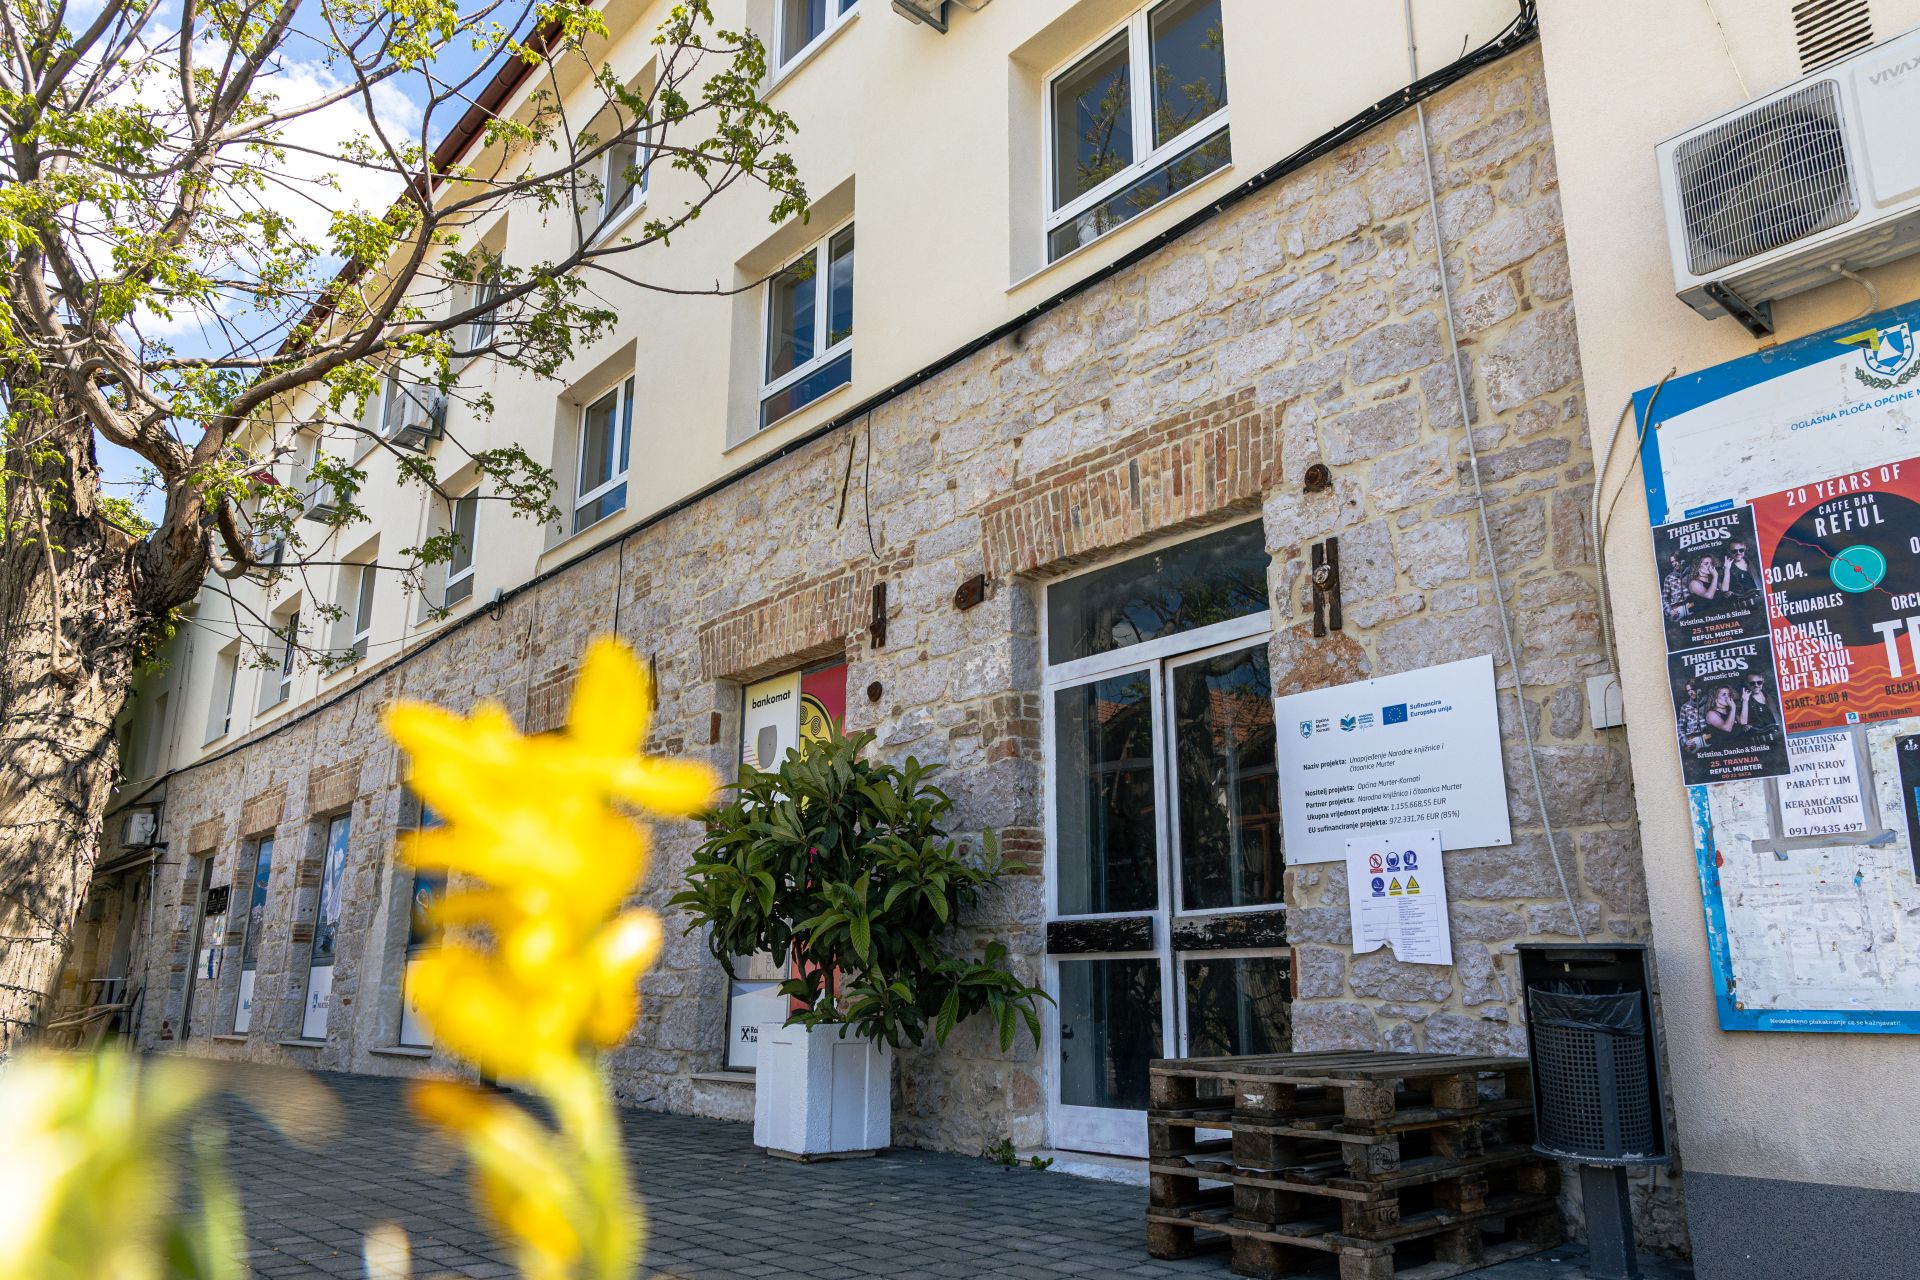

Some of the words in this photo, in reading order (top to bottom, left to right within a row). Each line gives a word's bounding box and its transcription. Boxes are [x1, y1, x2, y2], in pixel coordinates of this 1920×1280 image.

[1791, 413, 1837, 430] OGLASNA
[1839, 403, 1872, 417] PLOČA
[1786, 488, 1807, 506] 20
[1815, 471, 1871, 498] YEARS
[1880, 464, 1900, 482] OF
[1819, 500, 1850, 515] CAFFE
[1854, 494, 1875, 507] BAR
[1667, 522, 1701, 539] THREE
[1703, 513, 1740, 528] LITTLE
[1814, 504, 1885, 538] REFUL
[1680, 526, 1731, 549] BIRDS
[1687, 542, 1711, 552] acoustic
[1765, 562, 1808, 584] 30.04.
[1768, 591, 1788, 606] THE
[1771, 592, 1844, 619] EXPENDABLES
[1705, 613, 1726, 621] Danko
[1691, 634, 1714, 642] REFUL
[1714, 628, 1744, 638] MURTER
[1705, 621, 1741, 632] TRAVNJA
[1773, 619, 1832, 645] RAPHAEL
[1681, 651, 1717, 667] THREE
[1720, 644, 1758, 658] LITTLE
[1776, 633, 1843, 660] WRESSNIG
[1695, 657, 1749, 678] BIRDS
[1779, 659, 1789, 676] &
[1791, 654, 1816, 675] THE
[1819, 649, 1855, 670] SOUL
[1703, 673, 1727, 681] acoustic
[1782, 673, 1809, 692] GIFT
[1812, 666, 1850, 688] BAND
[1885, 681, 1914, 696] BEACH
[752, 690, 791, 709] bankomat
[1409, 699, 1442, 710] Sufinancira
[1785, 697, 1813, 710] START:
[1815, 692, 1839, 705] 20:00
[1410, 708, 1437, 717] Europska
[1438, 705, 1452, 713] unija
[1320, 759, 1347, 769] projekta:
[1388, 749, 1412, 758] Narodne
[1414, 744, 1440, 754] knjižnice
[1724, 747, 1745, 756] Danko
[1791, 743, 1836, 756] LIMARIJA
[1376, 760, 1395, 768] Murter
[1709, 767, 1732, 775] REFUL
[1733, 763, 1763, 772] MURTER
[1723, 756, 1759, 766] TRAVNJA
[1792, 763, 1816, 773] AVNI
[1818, 760, 1846, 770] KROV
[1305, 787, 1327, 797] Nositelj
[1328, 785, 1355, 795] projekta:
[1378, 774, 1421, 787] Murter-Kornati
[1786, 777, 1831, 790] PARAPET
[1833, 776, 1851, 785] LIM
[1328, 797, 1355, 807] projekta:
[1358, 793, 1381, 802] Narodna
[1383, 789, 1408, 799] knjižnica
[1441, 783, 1462, 791] Murter
[1785, 795, 1859, 809] KERAMIČARSKI
[1307, 813, 1329, 821] Ukupna
[1330, 808, 1361, 818] vrijednost
[1361, 805, 1389, 815] projekta:
[1433, 797, 1447, 805] EUR
[1804, 806, 1842, 816] RADOVI
[1308, 826, 1316, 834] EU
[1317, 821, 1359, 833] sufinanciranje
[1360, 819, 1388, 829] projekta:
[1427, 812, 1440, 820] EUR
[1440, 810, 1460, 820] (85%)
[1789, 824, 1841, 836] 091/9435
[1843, 823, 1863, 832] 497
